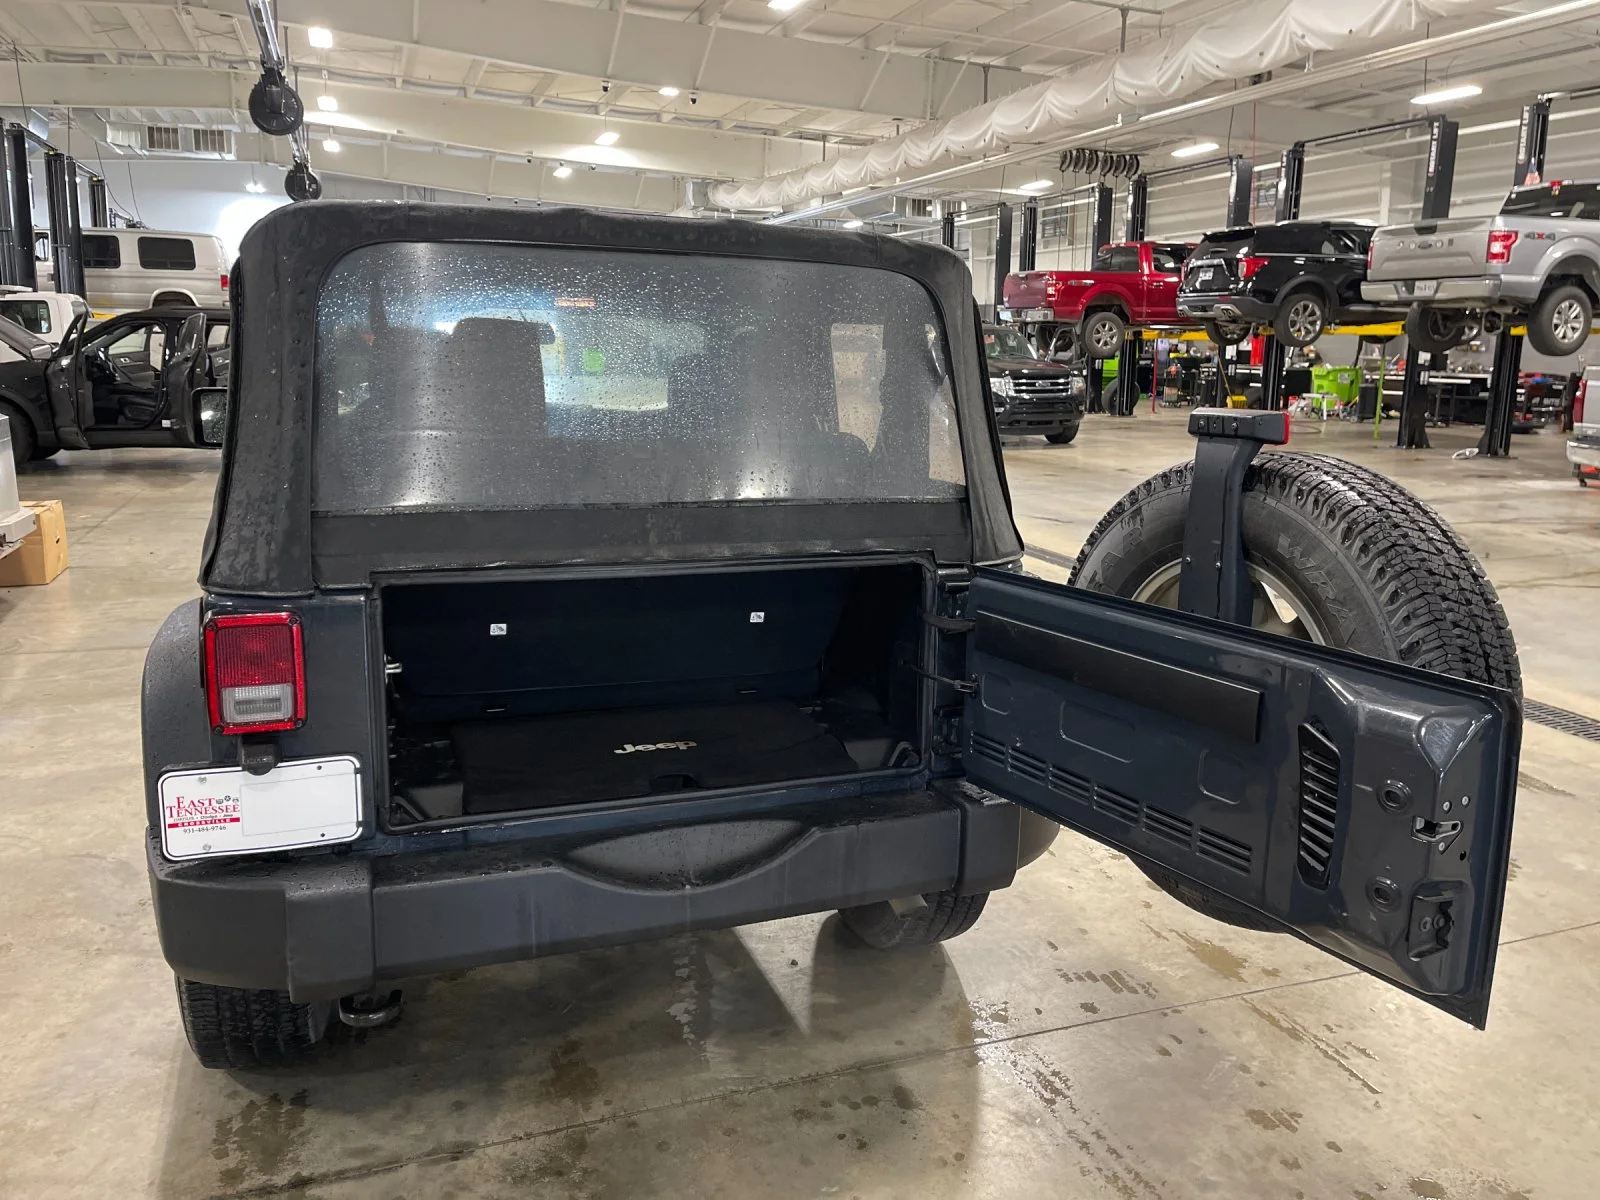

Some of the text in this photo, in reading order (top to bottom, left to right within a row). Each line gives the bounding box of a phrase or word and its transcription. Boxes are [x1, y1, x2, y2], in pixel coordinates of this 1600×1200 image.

[613, 741, 698, 754] Jeep
[166, 804, 240, 819] TENNESSEE
[178, 818, 231, 827] CROSSVILLE
